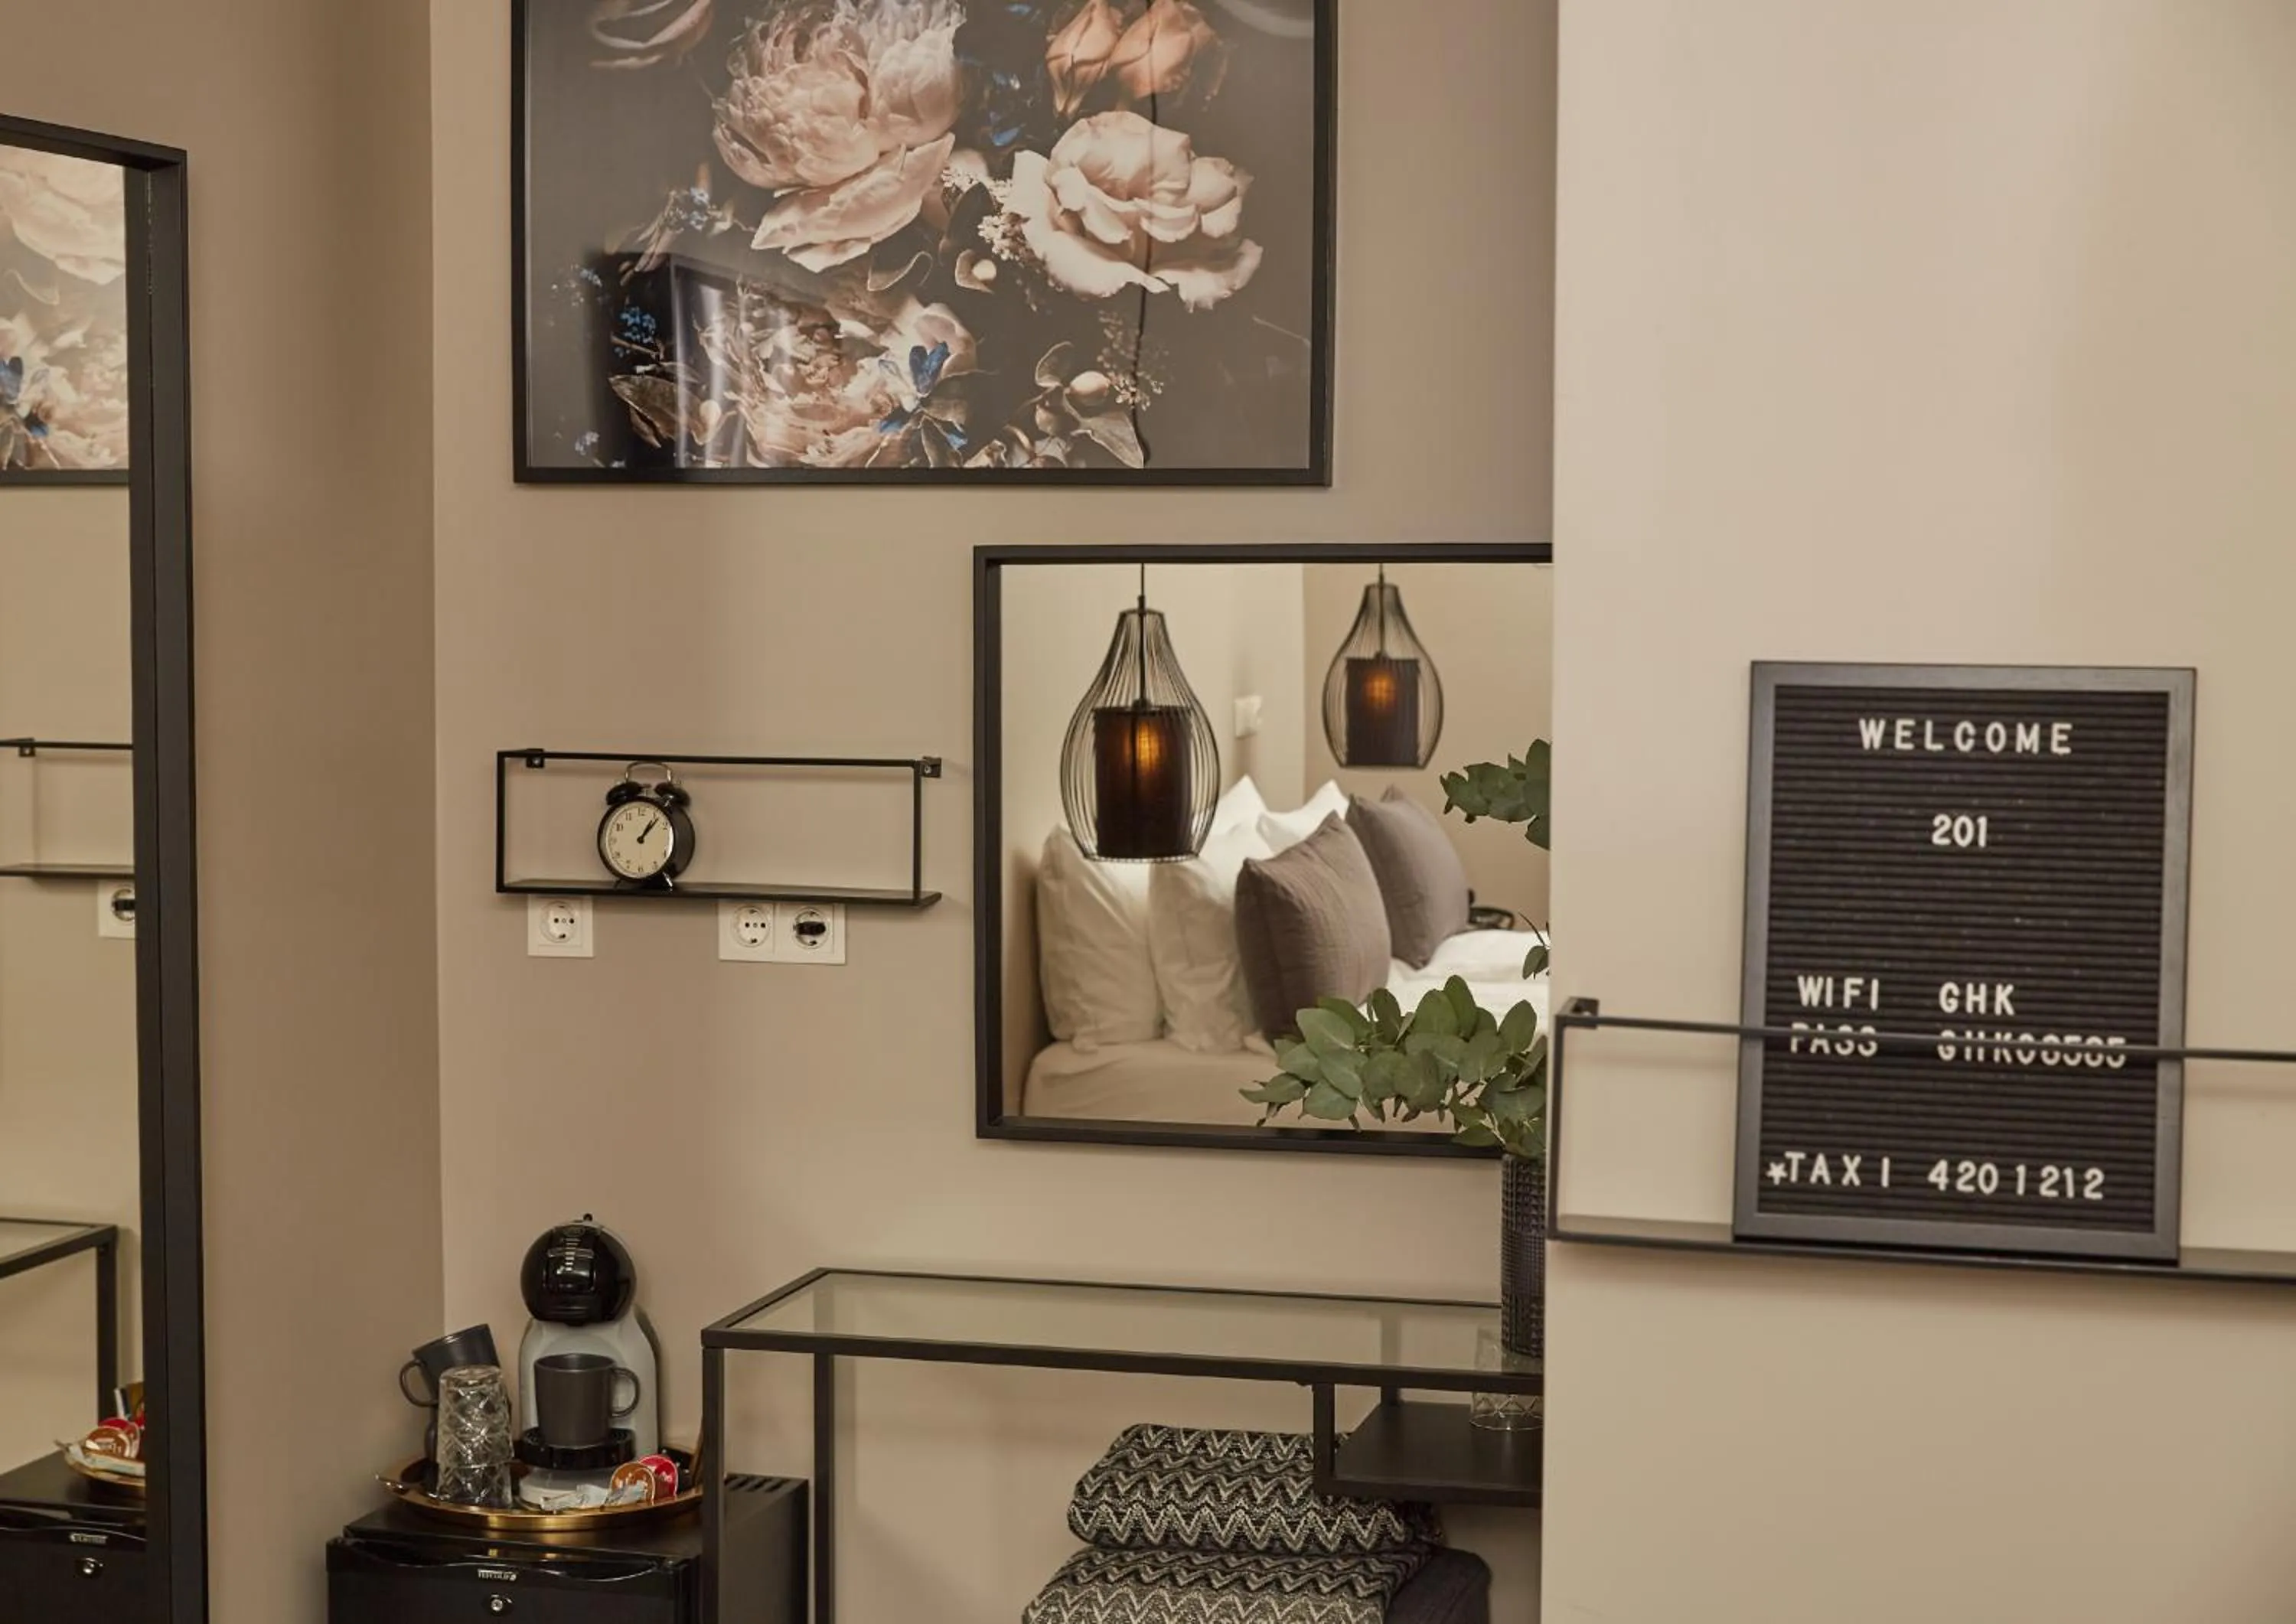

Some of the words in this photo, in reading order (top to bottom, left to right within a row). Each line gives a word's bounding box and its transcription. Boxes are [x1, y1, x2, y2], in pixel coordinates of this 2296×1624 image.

[1859, 718, 2073, 755] WELCOME
[1932, 814, 1988, 848] 201
[1798, 975, 1879, 1010] WIFI
[1939, 982, 2015, 1016] GHK
